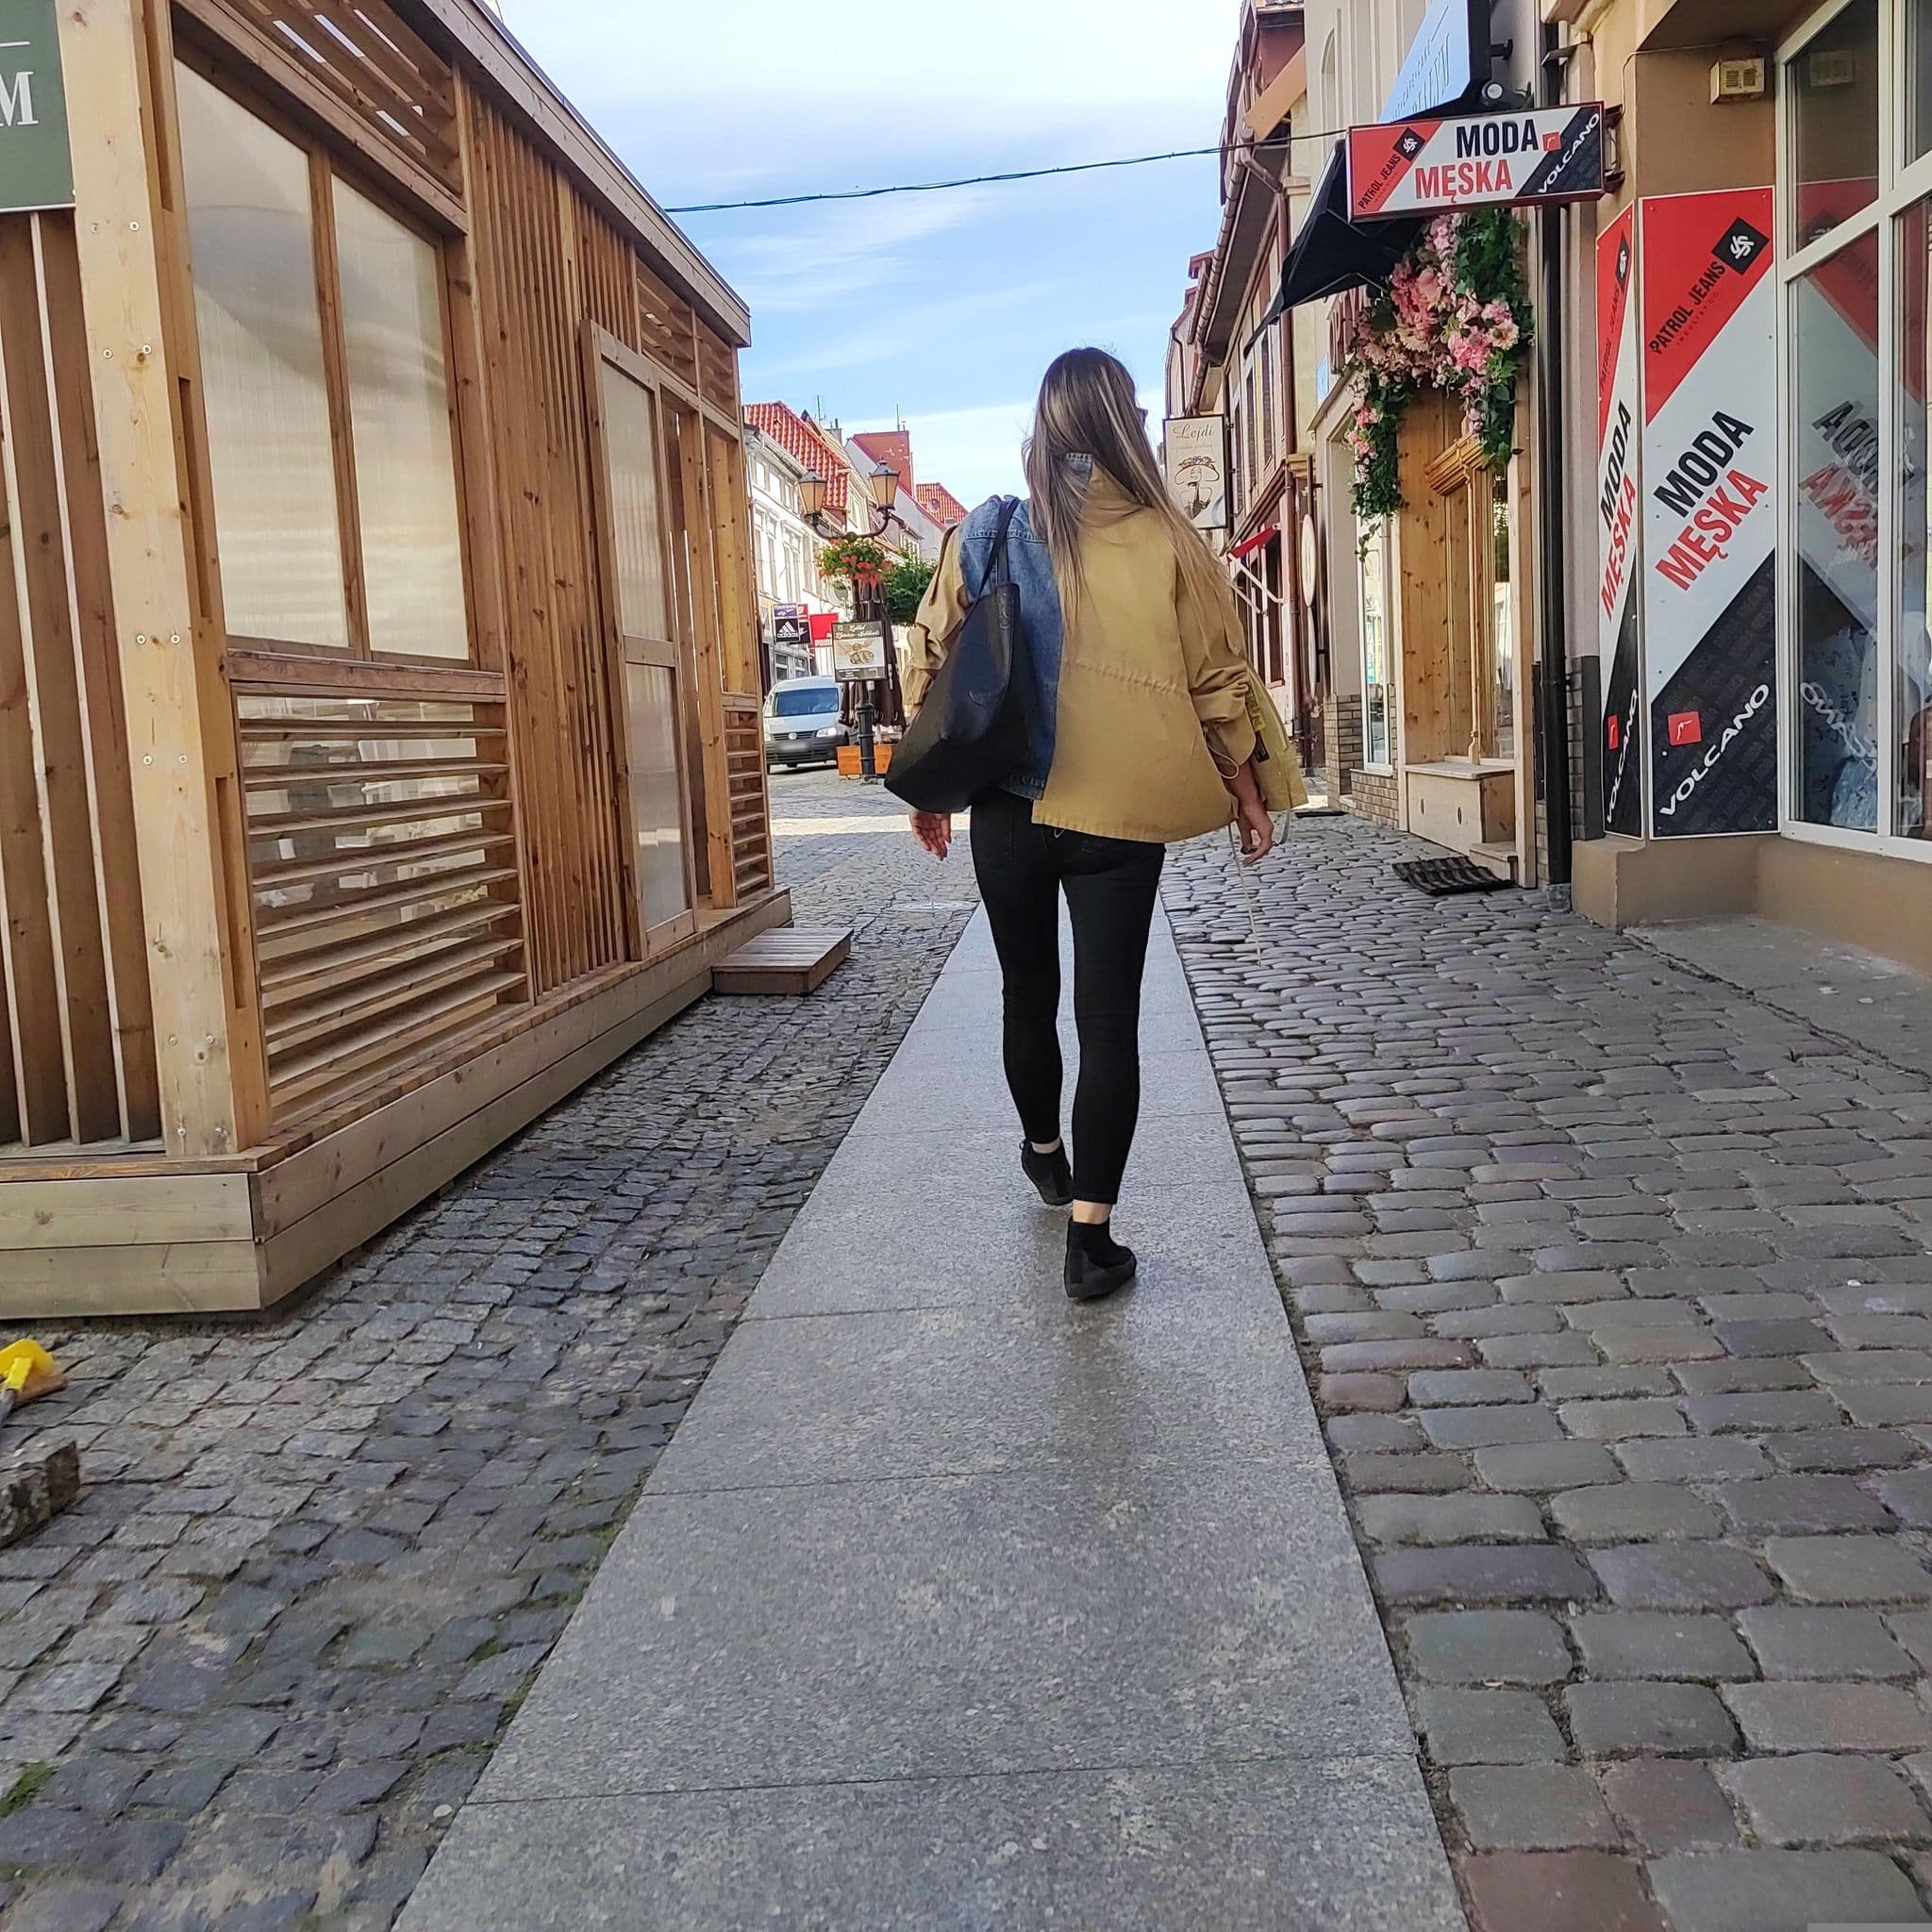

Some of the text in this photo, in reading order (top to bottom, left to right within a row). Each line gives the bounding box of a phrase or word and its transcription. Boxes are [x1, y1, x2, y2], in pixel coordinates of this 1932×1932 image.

[1357, 180, 1383, 209] PATROL
[1380, 153, 1402, 180] JEANS
[1415, 159, 1512, 203] MĘSKA
[1457, 119, 1539, 158] MODA
[1538, 113, 1599, 193] VOLCANO
[1649, 260, 1726, 355] PATROL JEANS
[1173, 424, 1215, 441] Lejdi
[1600, 399, 1631, 531] MODA
[1653, 409, 1755, 519] MODA
[1601, 472, 1636, 623] MĘSKA
[1656, 468, 1769, 591] MĘSKA
[1658, 684, 1770, 816] VOLCANO
